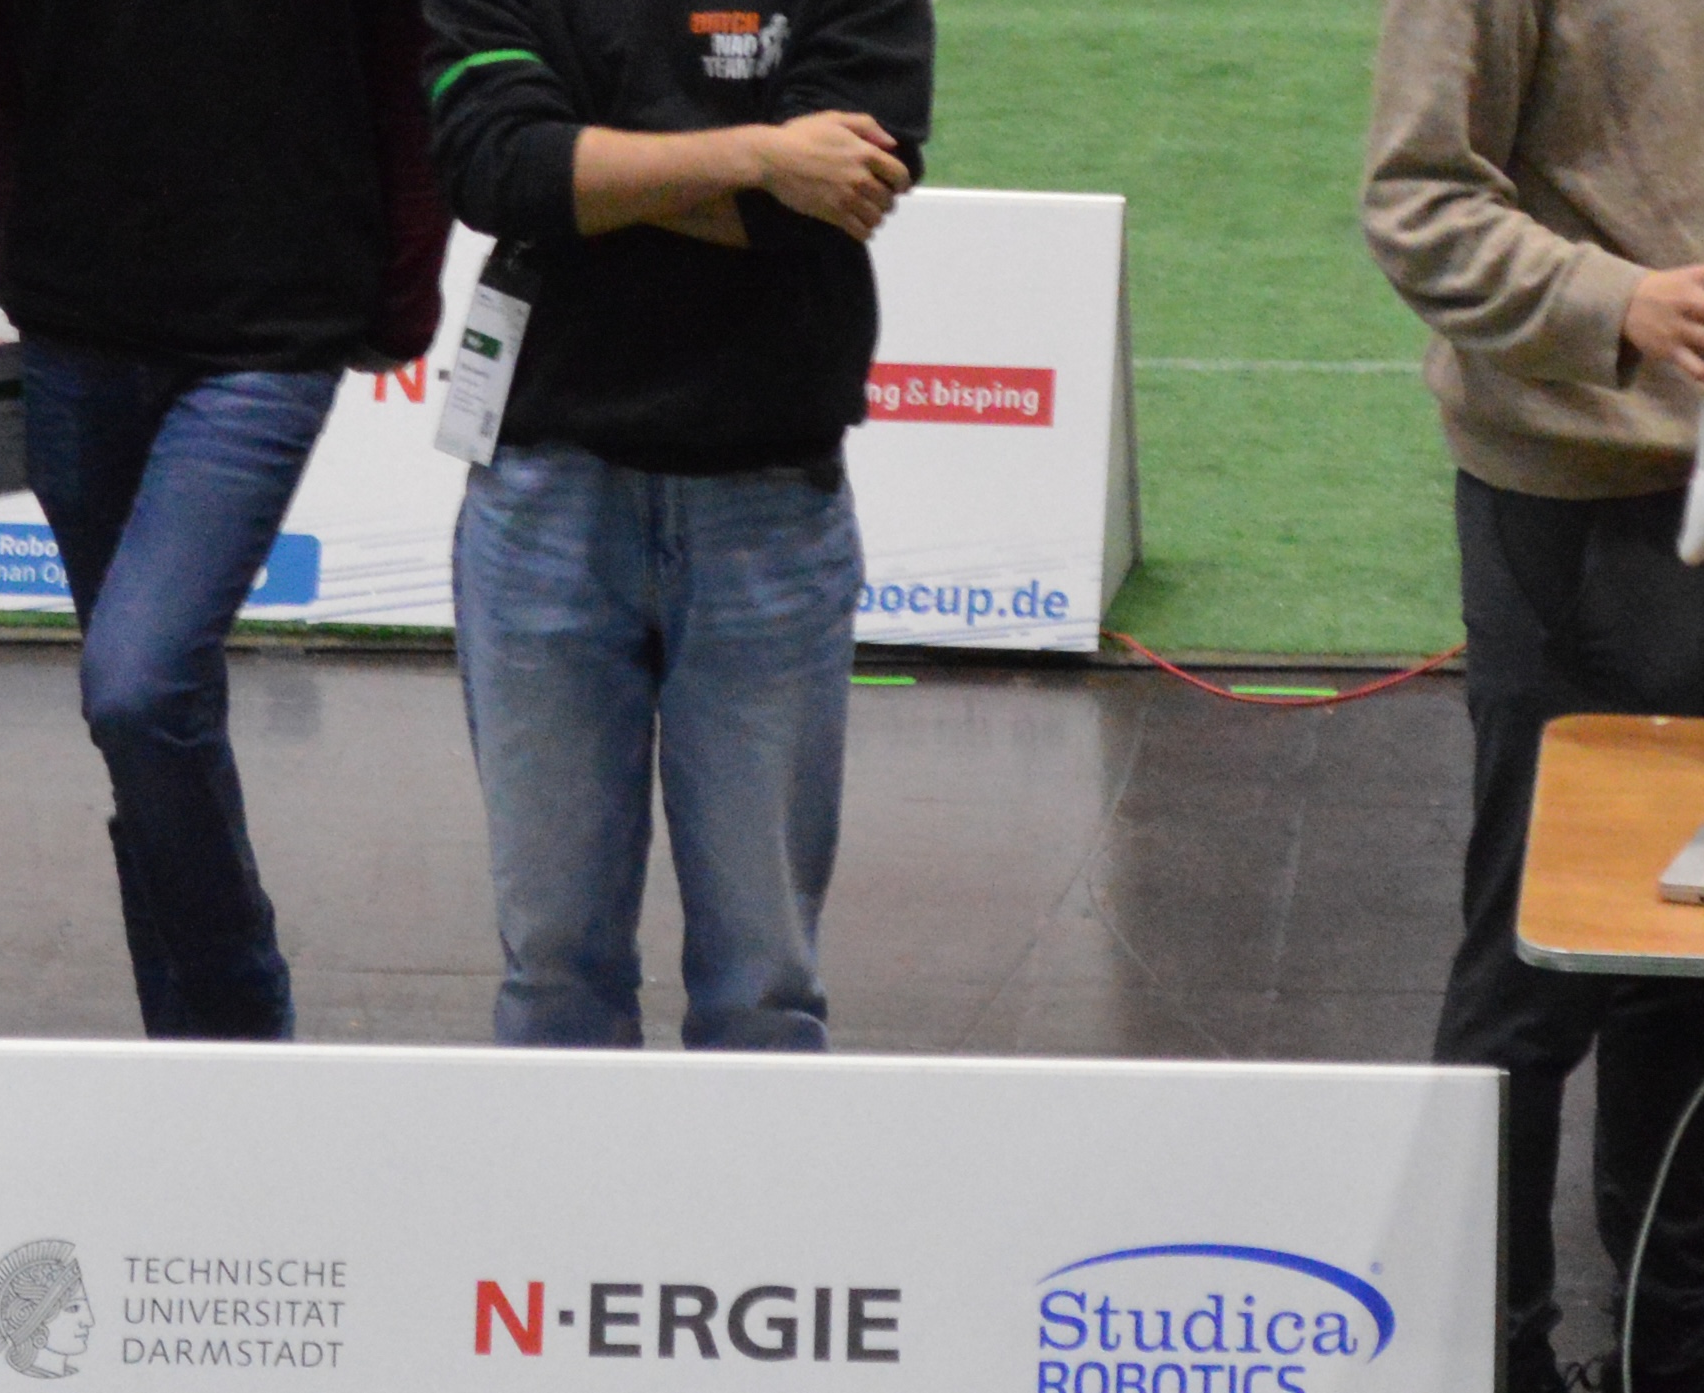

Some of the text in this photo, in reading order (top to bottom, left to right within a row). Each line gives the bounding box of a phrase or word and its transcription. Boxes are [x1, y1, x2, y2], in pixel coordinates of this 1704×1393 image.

[906, 378, 929, 406] &
[933, 379, 1040, 416] bisping
[0, 533, 60, 559] Robo
[124, 1254, 347, 1290] TECHNISCHE
[122, 1294, 345, 1330] UNIVERSITÄT
[1037, 1289, 1359, 1357] Studica
[120, 1336, 344, 1370] DARMSTADT
[1037, 1359, 1308, 1393] ROBOTICS
